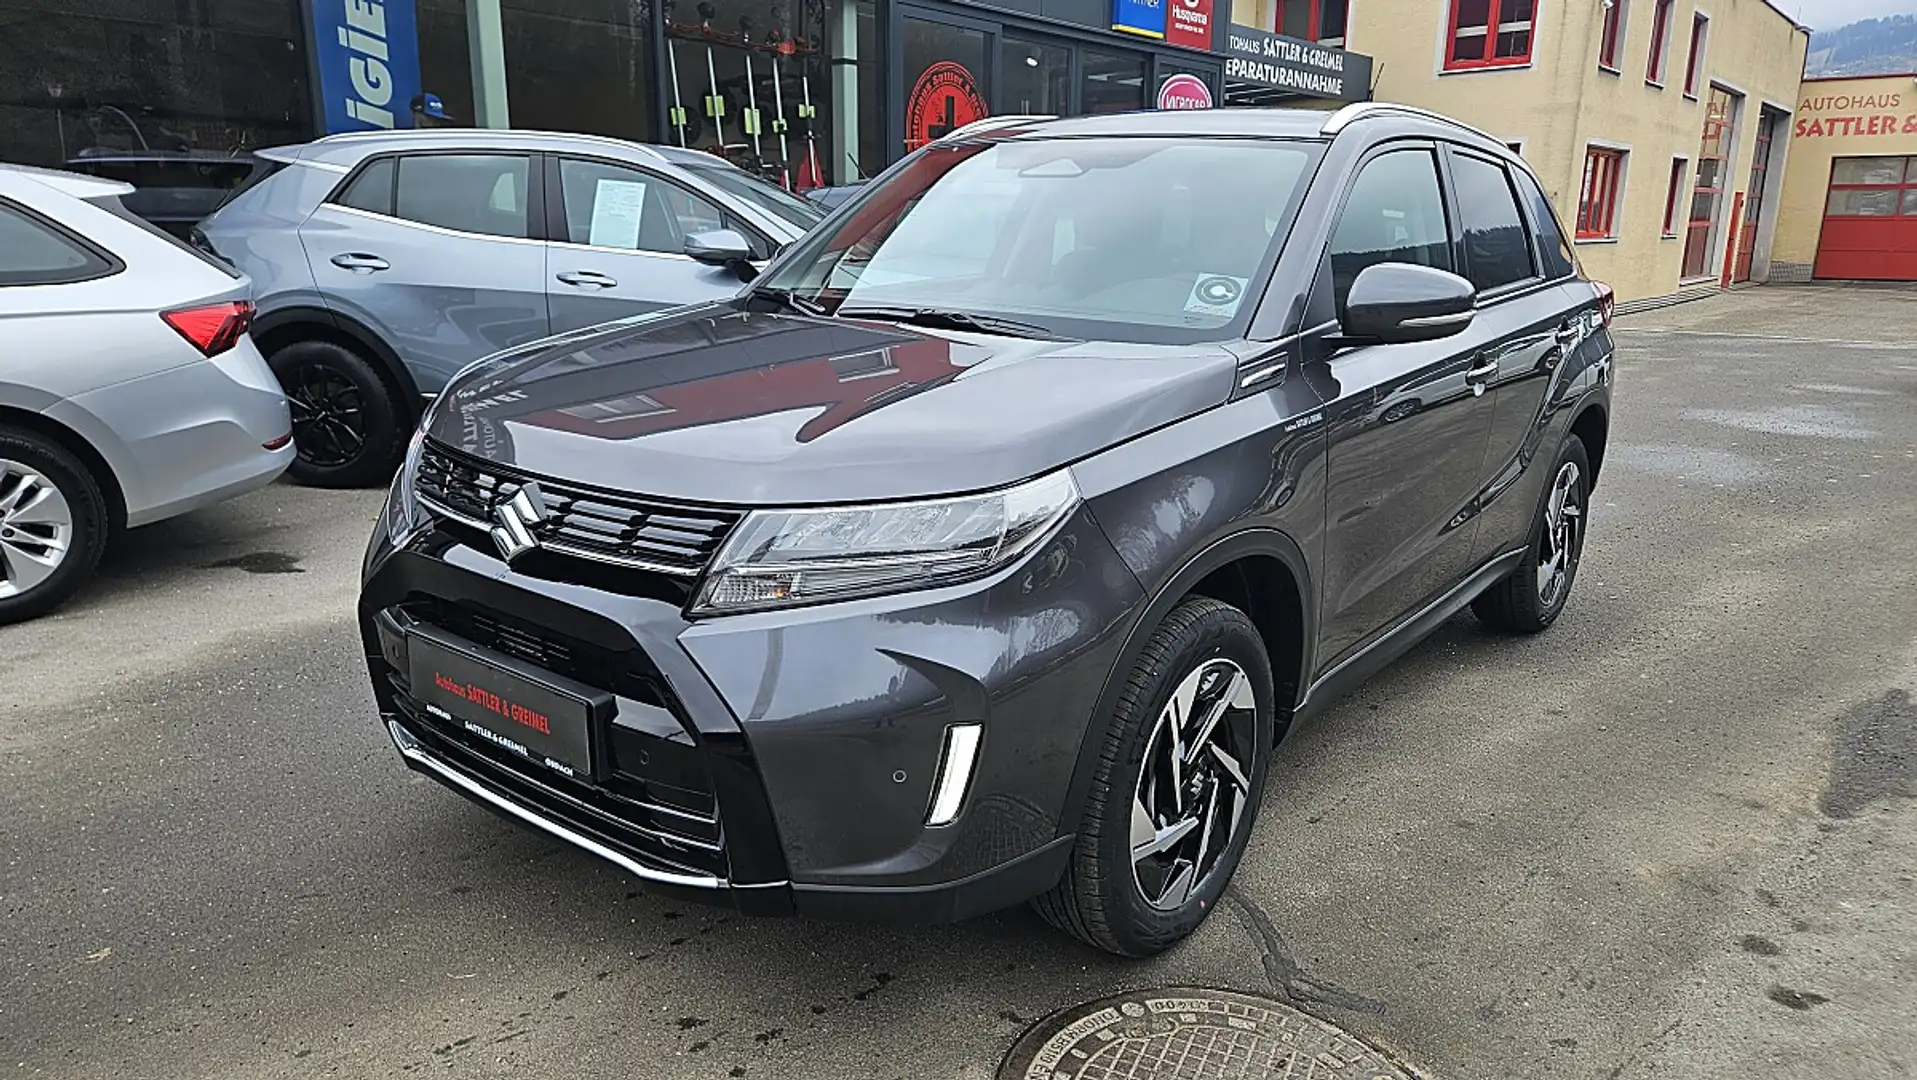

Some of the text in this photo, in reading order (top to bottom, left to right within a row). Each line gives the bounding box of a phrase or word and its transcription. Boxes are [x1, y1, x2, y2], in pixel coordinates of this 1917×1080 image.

[1229, 35, 1260, 54] TOHAUS
[1263, 37, 1300, 64] SATTLER
[1308, 49, 1343, 72] GREIMEL
[1226, 58, 1343, 95] EPARATURANNAHME
[1799, 94, 1900, 112] AUTOHAUS
[1795, 115, 1898, 138] SATTLER
[466, 684, 501, 714] SATTLER
[503, 700, 509, 717] &
[511, 703, 551, 735] GREIMEL
